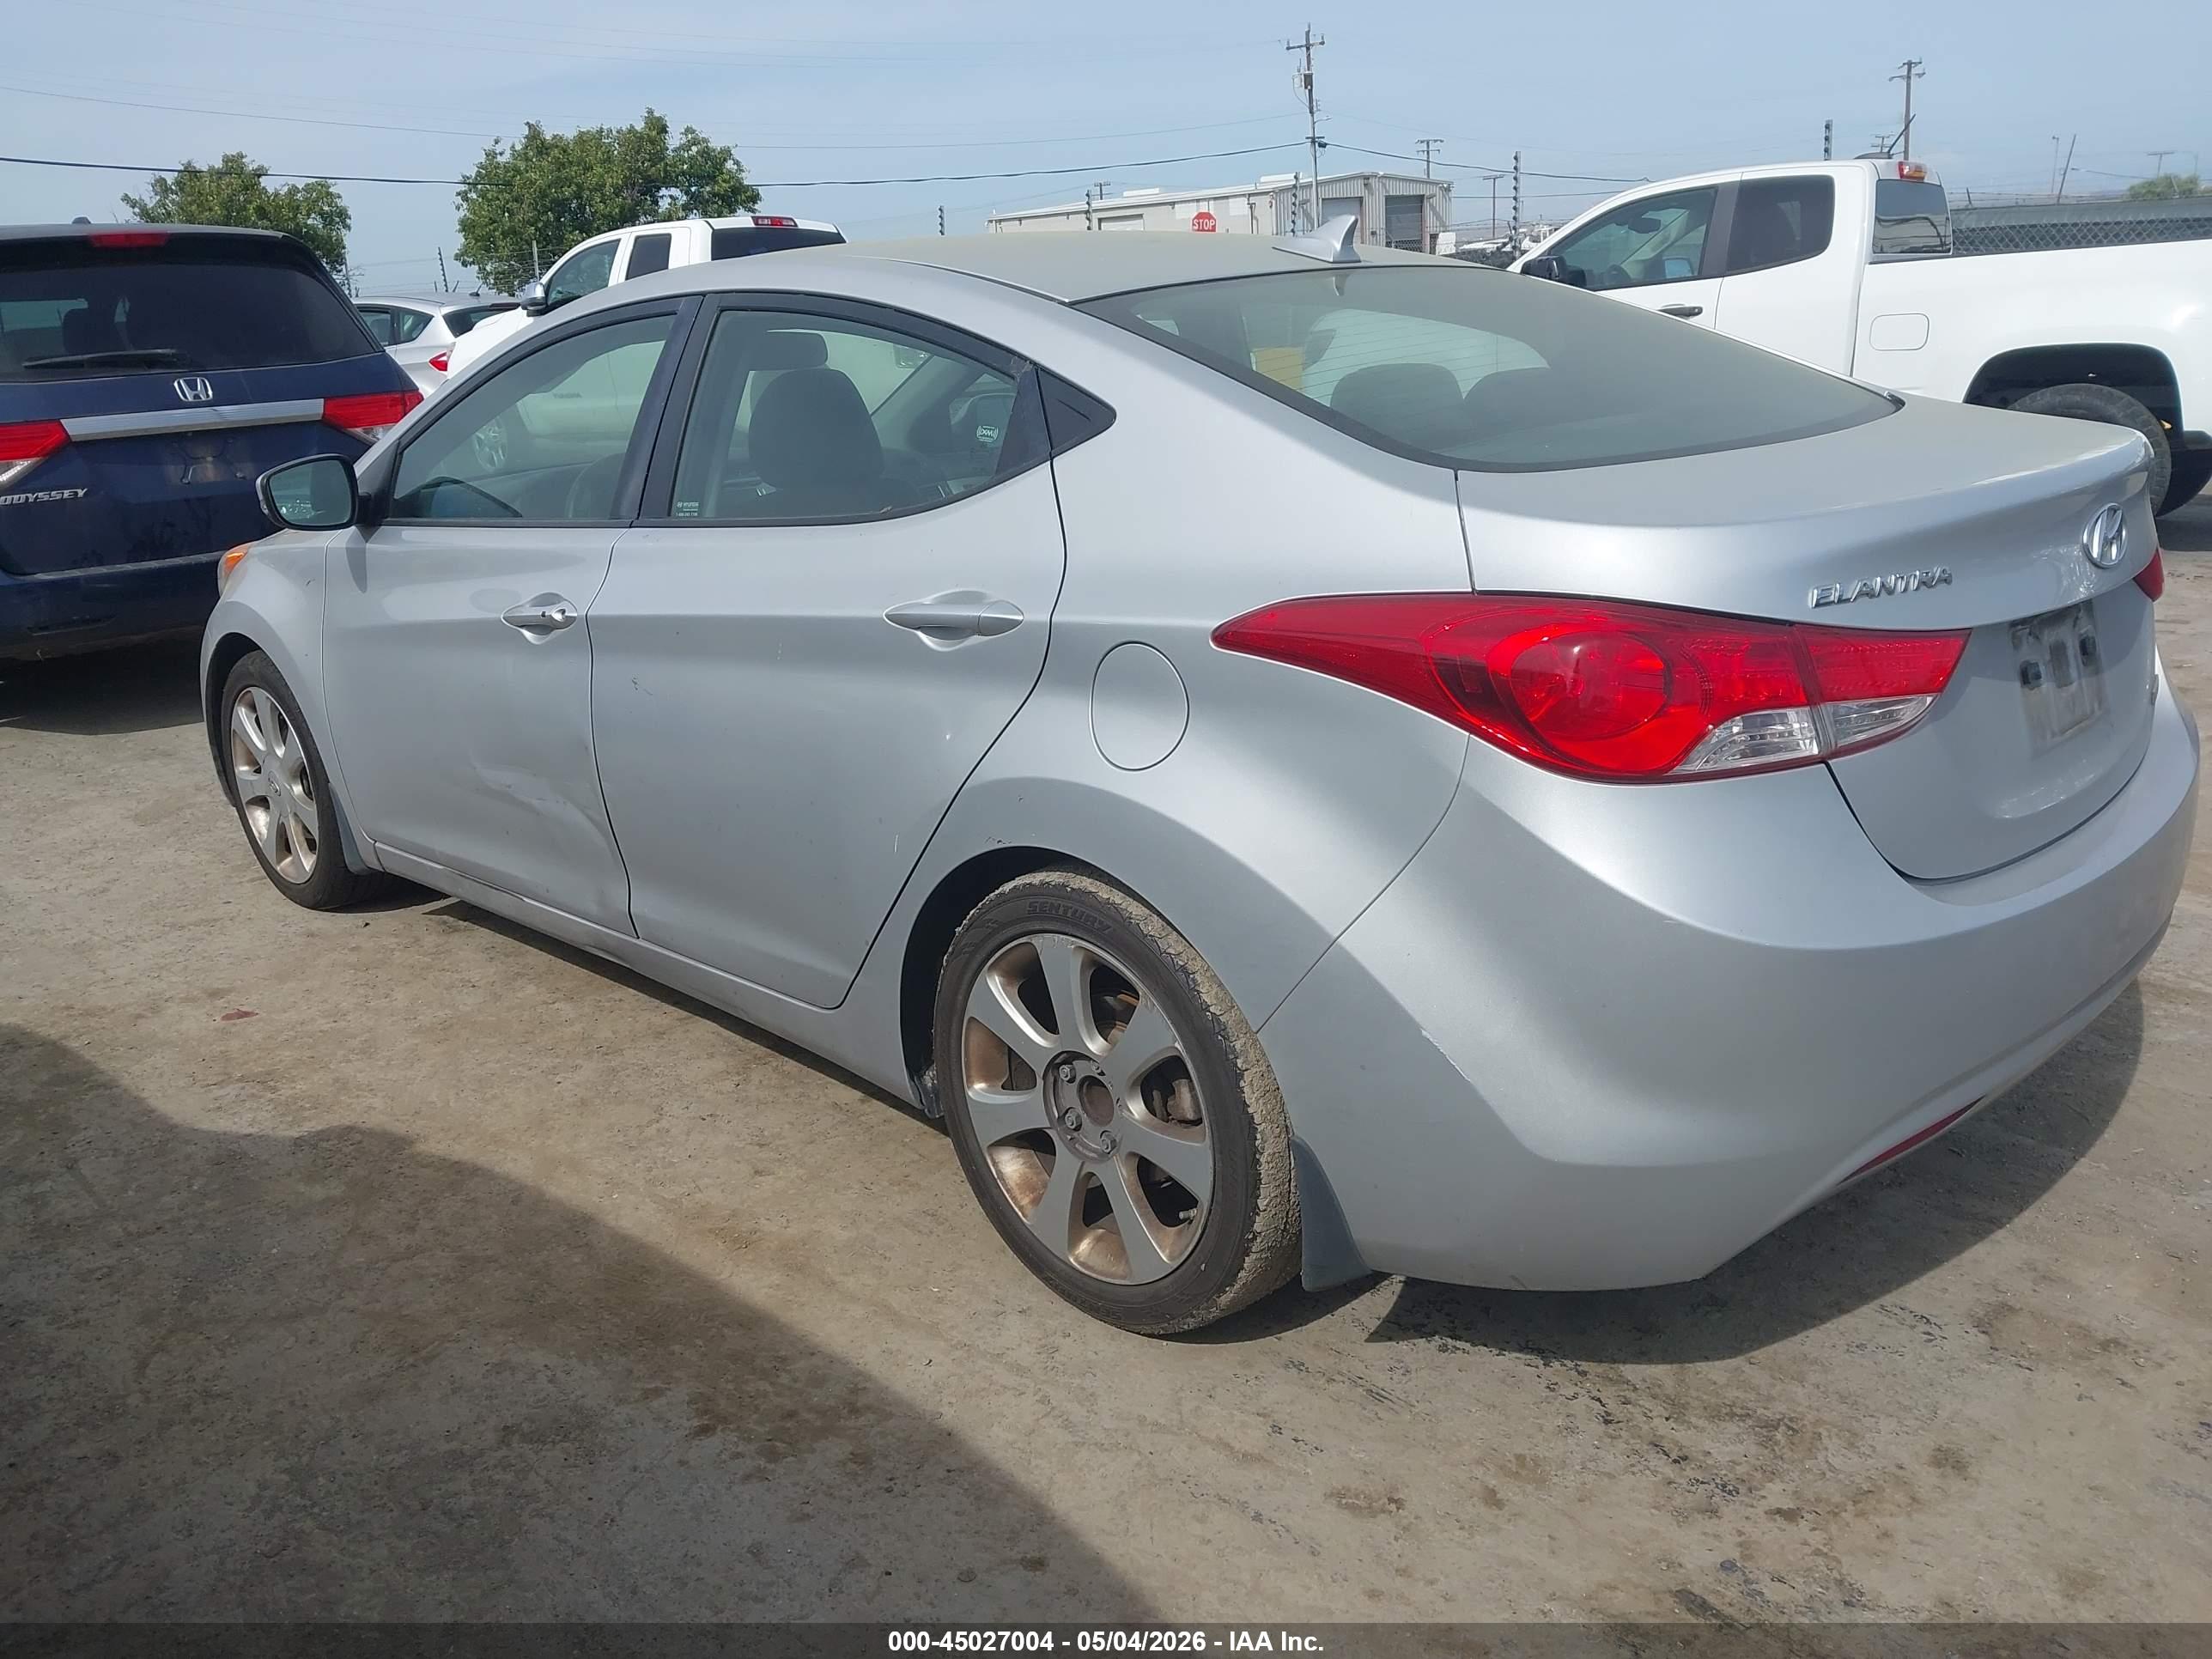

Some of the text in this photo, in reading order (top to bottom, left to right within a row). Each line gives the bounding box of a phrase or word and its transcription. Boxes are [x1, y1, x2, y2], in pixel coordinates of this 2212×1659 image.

[1194, 218, 1216, 230] STOP
[0, 488, 88, 505] ODYSSEY
[1808, 567, 1953, 609] ELANTRA
[1027, 902, 1113, 933] SENTURY
